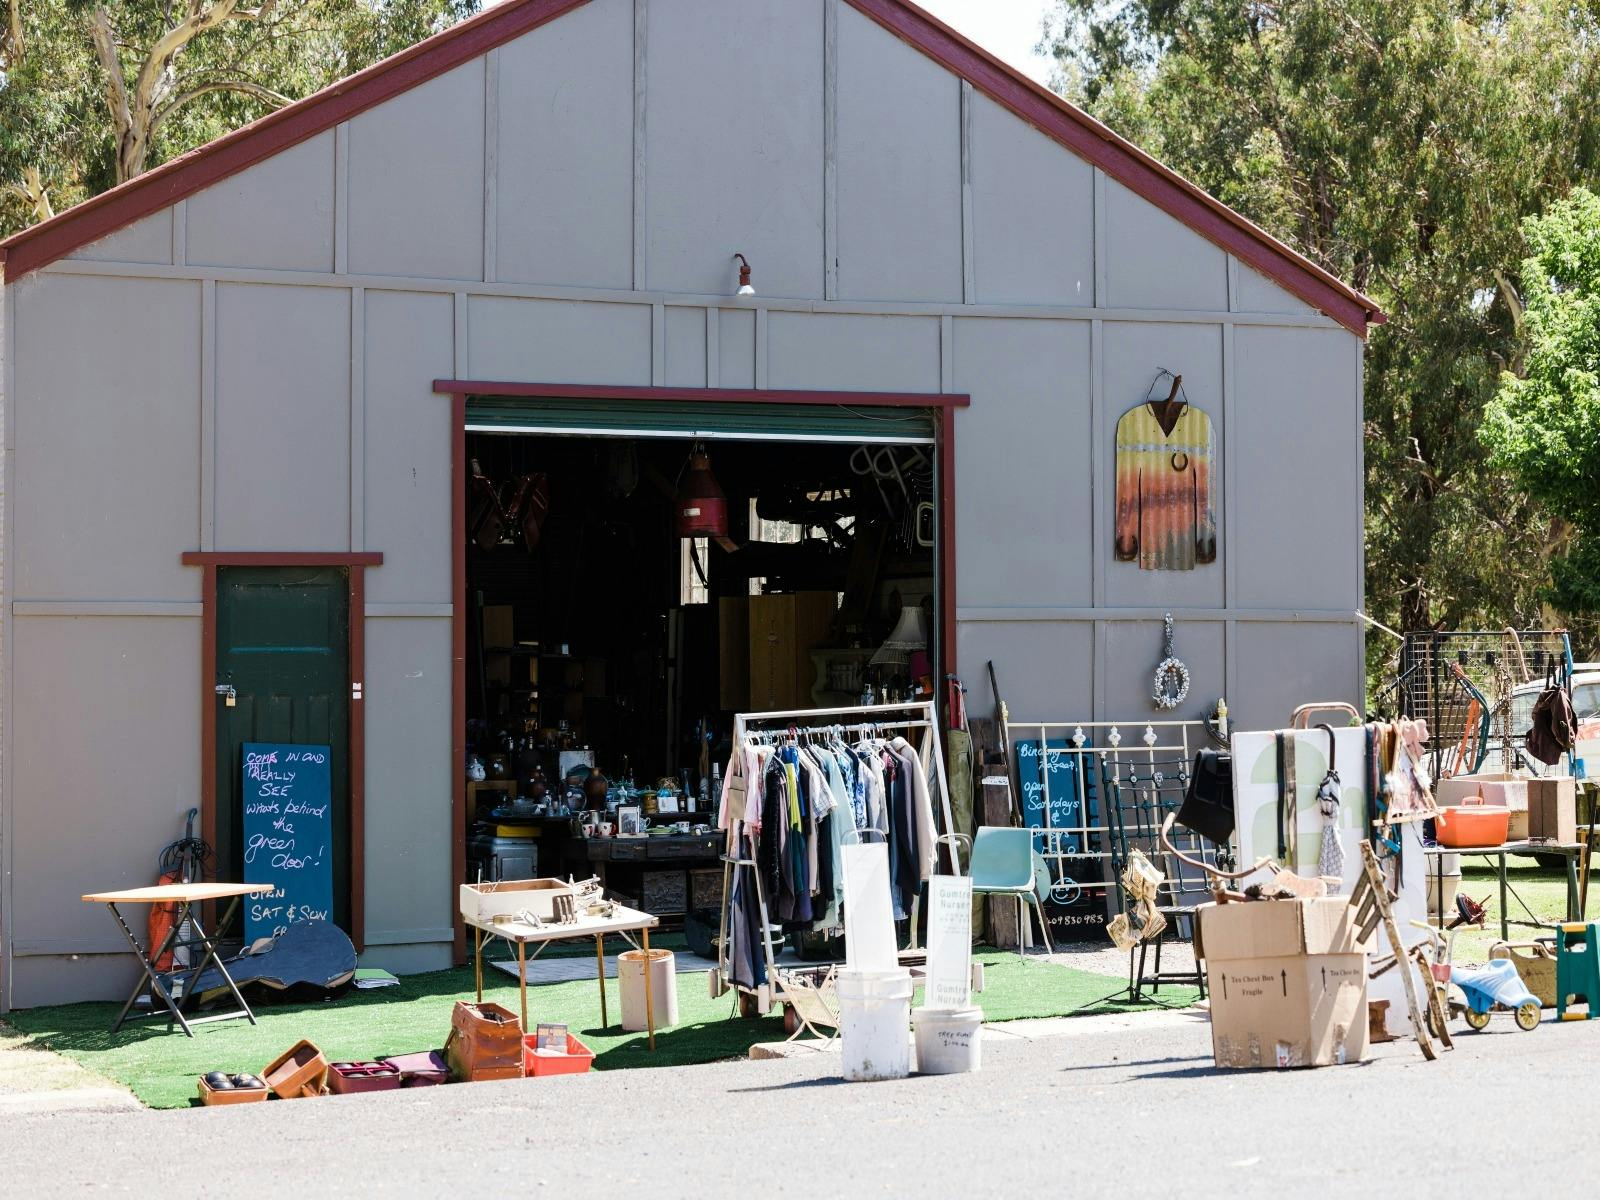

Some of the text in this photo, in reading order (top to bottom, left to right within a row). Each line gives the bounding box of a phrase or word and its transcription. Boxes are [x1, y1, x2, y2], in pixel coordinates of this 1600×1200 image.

[285, 752, 301, 762] IN
[259, 783, 293, 797] SEE
[284, 799, 327, 819] behind
[273, 816, 295, 834] the
[244, 833, 295, 864] green
[251, 904, 284, 921] SAT
[1231, 976, 1242, 984] Tea
[1242, 988, 1264, 997] Fragile
